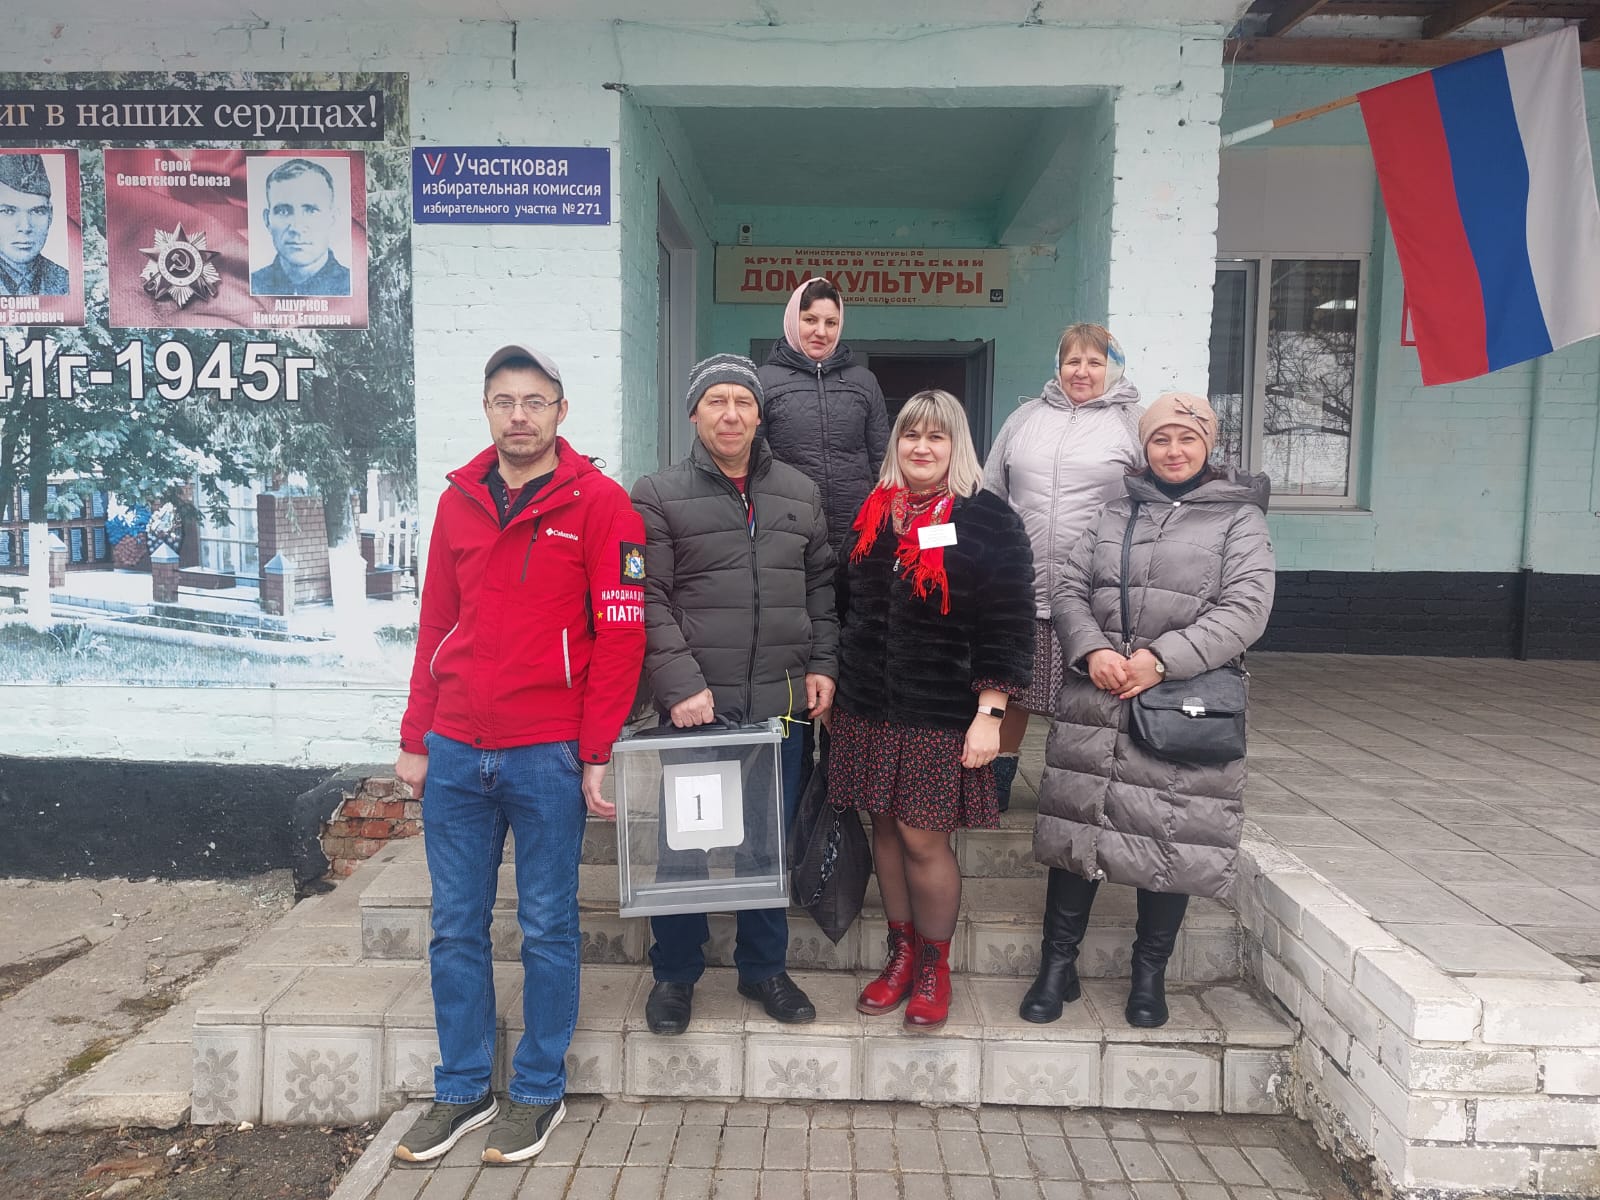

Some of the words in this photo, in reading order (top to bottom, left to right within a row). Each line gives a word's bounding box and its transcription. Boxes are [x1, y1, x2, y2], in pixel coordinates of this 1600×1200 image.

[45, 104, 66, 127] в
[77, 103, 204, 128] наших
[214, 95, 378, 136] сердцах!
[154, 158, 192, 173] Герой
[453, 152, 569, 176] Участковая
[116, 173, 187, 187] Советского
[189, 173, 231, 187] Союза
[422, 179, 529, 199] избирательная
[533, 183, 601, 196] комиссия
[423, 202, 510, 217] избирательного
[514, 204, 557, 217] участка
[562, 203, 602, 216] №271
[740, 268, 812, 293] ДОМ
[825, 270, 983, 294] КУЛЬТУРЫ
[274, 299, 329, 312] АШУРКОВ
[8, 309, 65, 323] Егорович
[252, 311, 297, 325] Никита
[298, 312, 351, 326] Егорович
[601, 589, 637, 602] НАРОДНАЯ
[691, 793, 705, 821] 1
